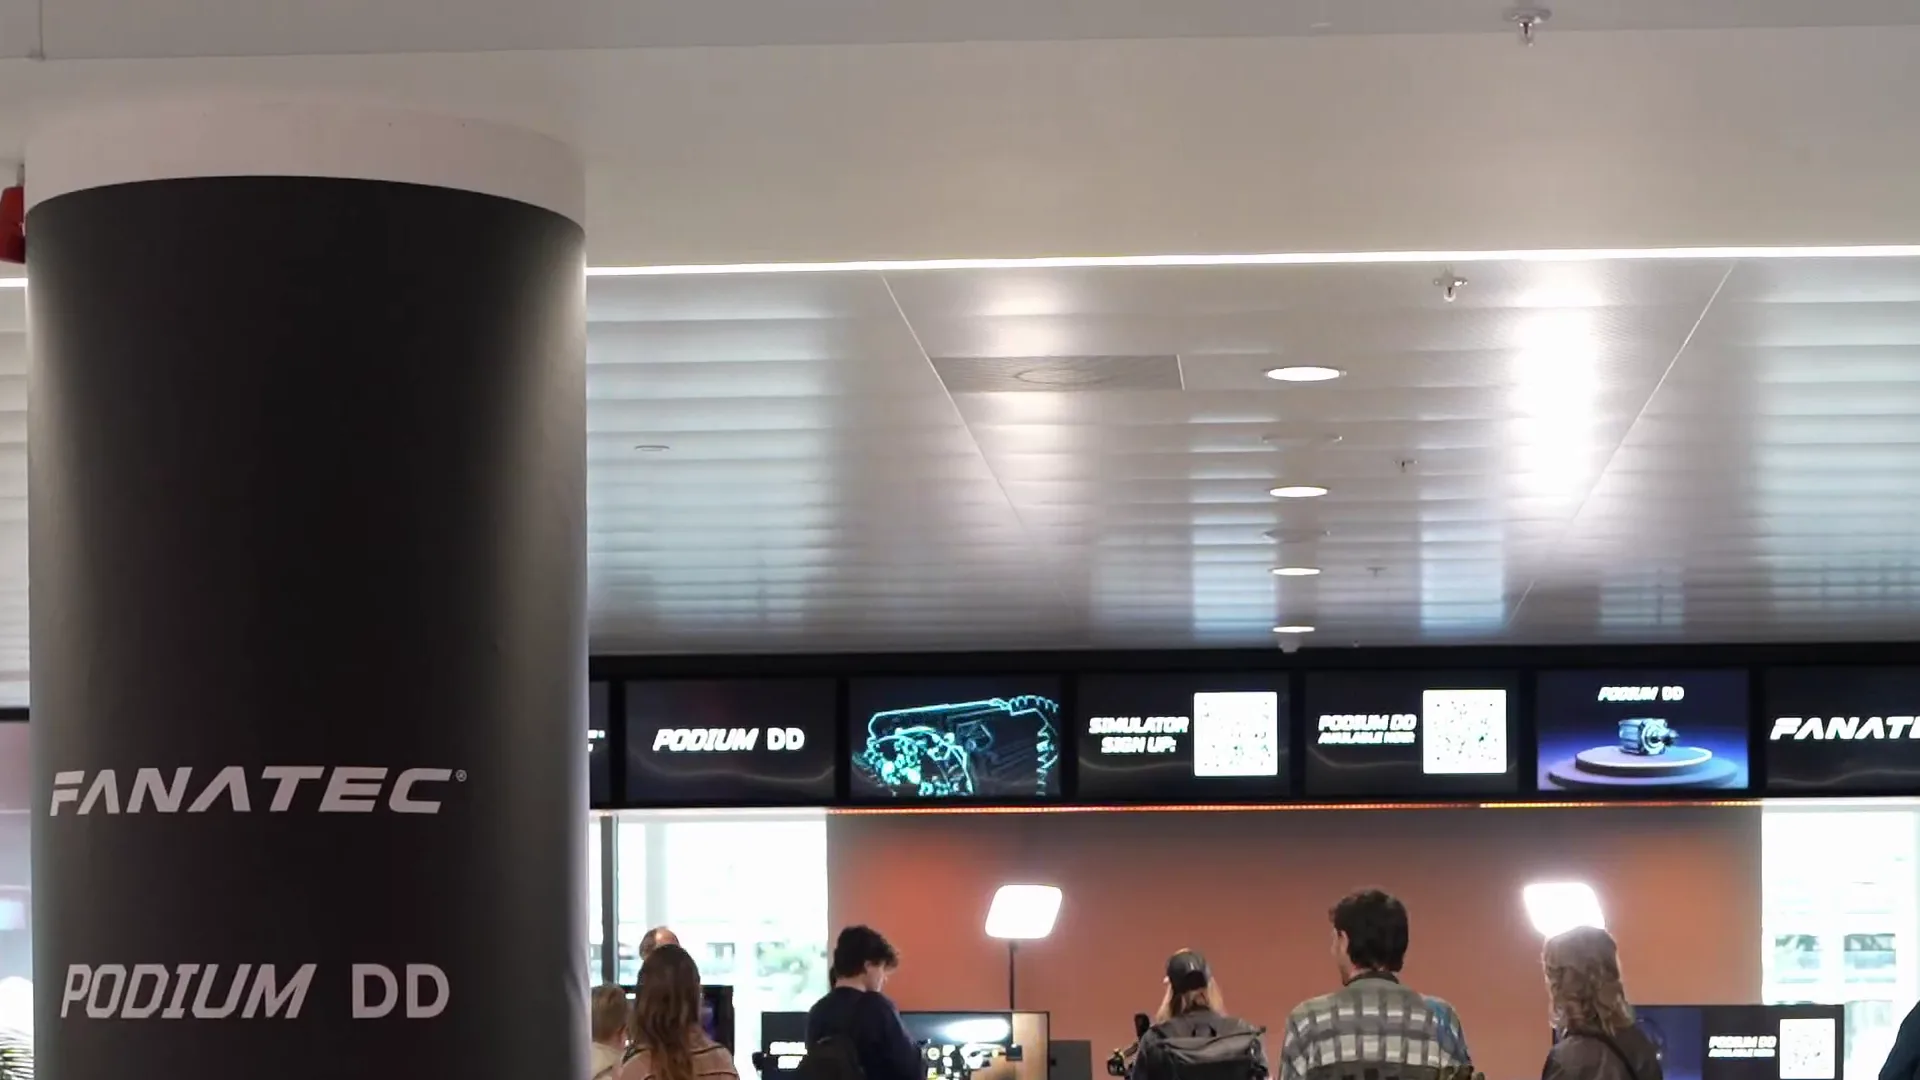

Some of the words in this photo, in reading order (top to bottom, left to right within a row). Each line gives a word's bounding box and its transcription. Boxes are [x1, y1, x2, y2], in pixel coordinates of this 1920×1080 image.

[1598, 686, 1659, 701] PODIUM
[1661, 685, 1685, 701] DD
[1088, 716, 1190, 734] SIMULATOR
[1318, 714, 1389, 732] PODIUM
[1389, 713, 1418, 731] DD
[652, 728, 759, 751] PODIUM
[767, 727, 806, 751] DD
[1101, 736, 1146, 754] SIGN
[61, 963, 317, 1019] PODIUM
[352, 963, 449, 1019] DD
